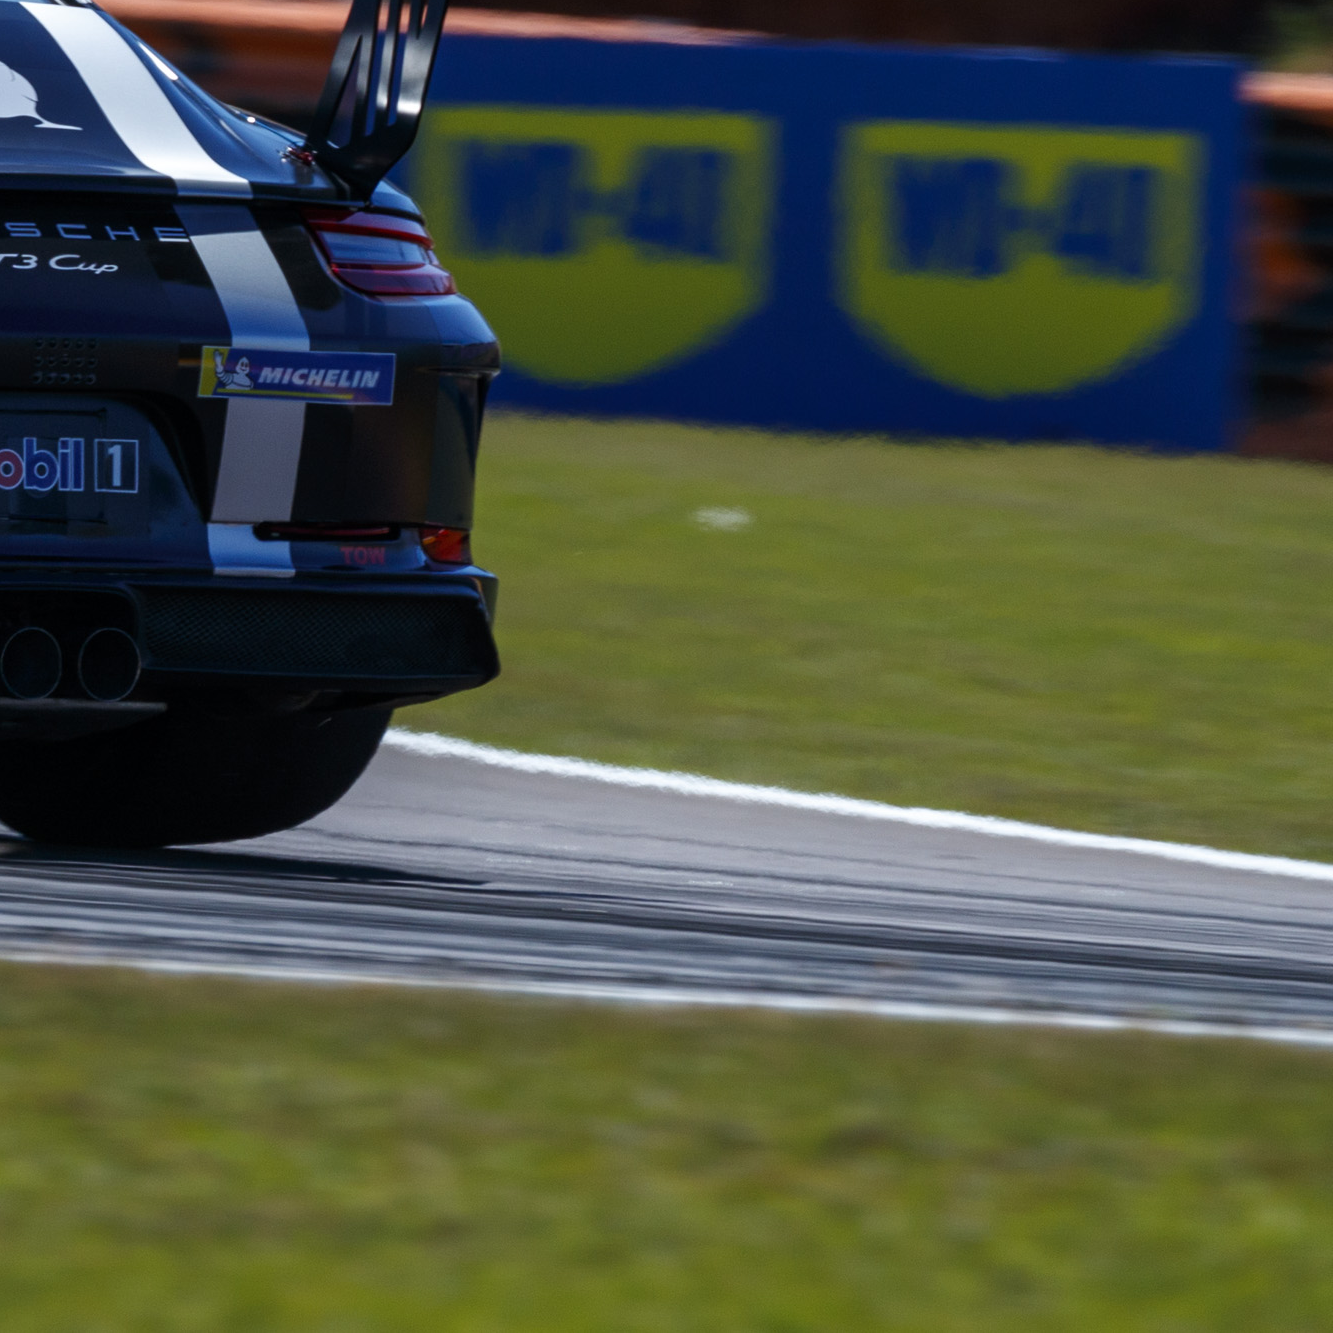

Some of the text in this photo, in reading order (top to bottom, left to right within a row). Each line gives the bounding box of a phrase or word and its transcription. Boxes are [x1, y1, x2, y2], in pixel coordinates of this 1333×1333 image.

[49, 252, 120, 275] Cup
[257, 367, 381, 389] MICHELIN
[339, 545, 387, 566] TOW
